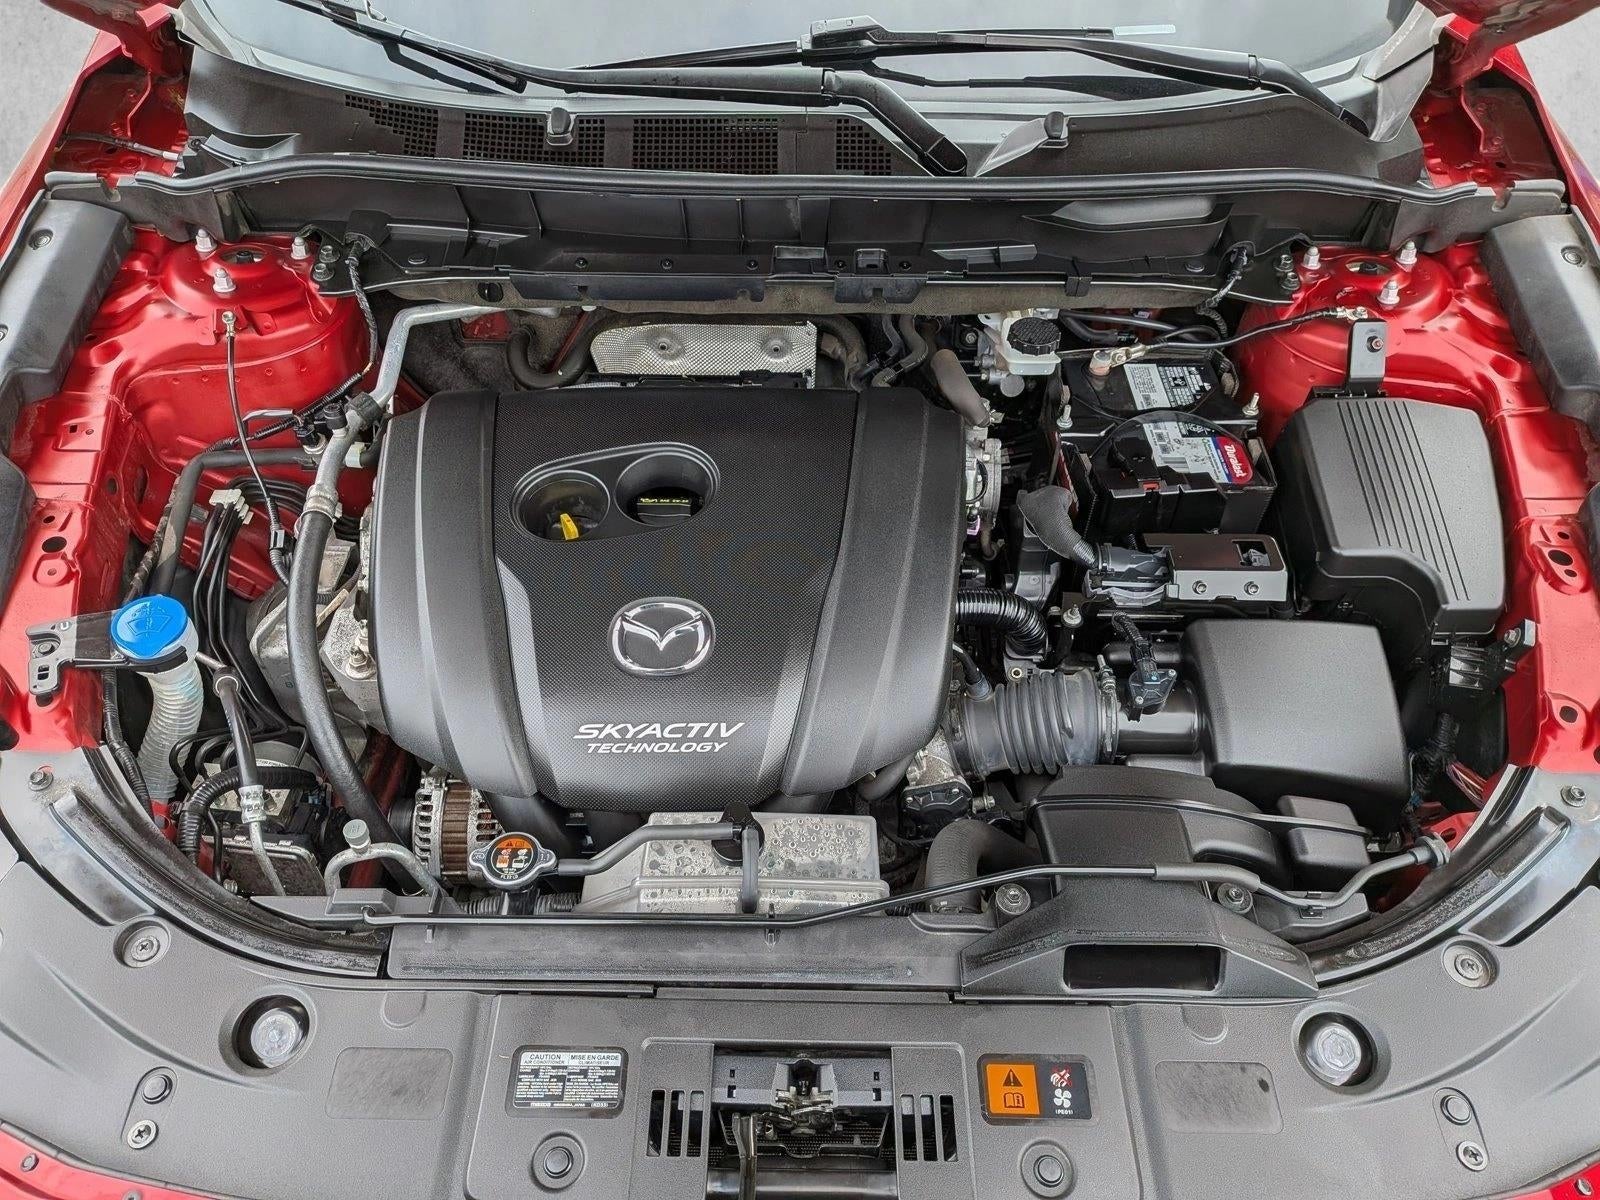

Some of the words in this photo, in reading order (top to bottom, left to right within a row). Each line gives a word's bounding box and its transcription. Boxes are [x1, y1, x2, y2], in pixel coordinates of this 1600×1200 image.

[1224, 444, 1247, 478] Duralast
[572, 722, 746, 739] SKYACTIV
[586, 741, 729, 754] TECHNOLOGY
